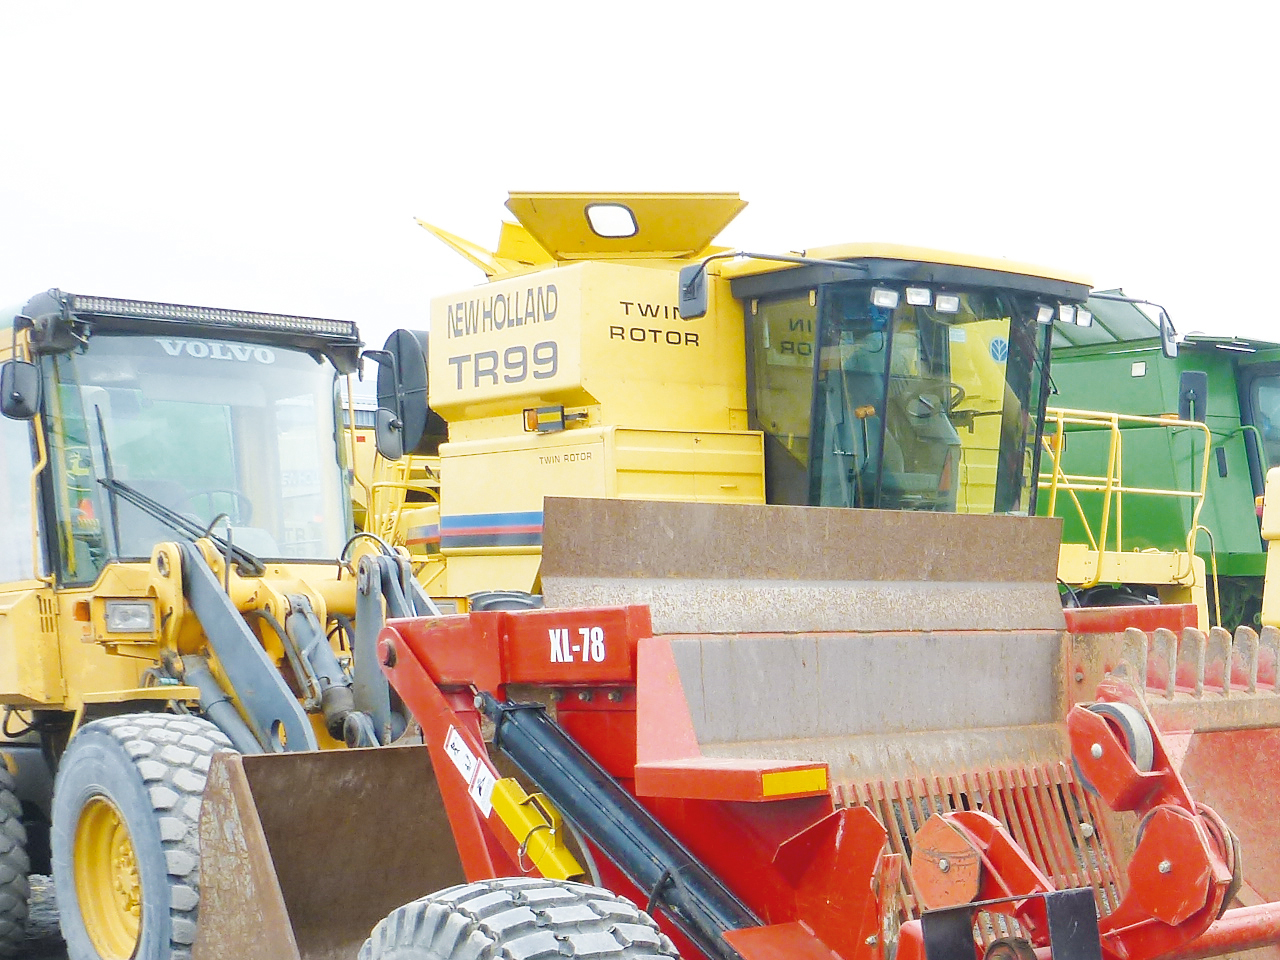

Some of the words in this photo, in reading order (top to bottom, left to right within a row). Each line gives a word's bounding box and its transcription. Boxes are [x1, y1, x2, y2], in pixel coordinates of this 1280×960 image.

[447, 299, 480, 339] NEW
[482, 284, 558, 333] HOLLAND
[619, 301, 680, 320] TWIN
[609, 325, 700, 347] ROTOR
[155, 339, 276, 365] VOLVO
[448, 340, 559, 390] TR99
[539, 455, 560, 465] TWIN
[563, 452, 592, 462] ROTOR
[548, 626, 606, 663] XL-78
